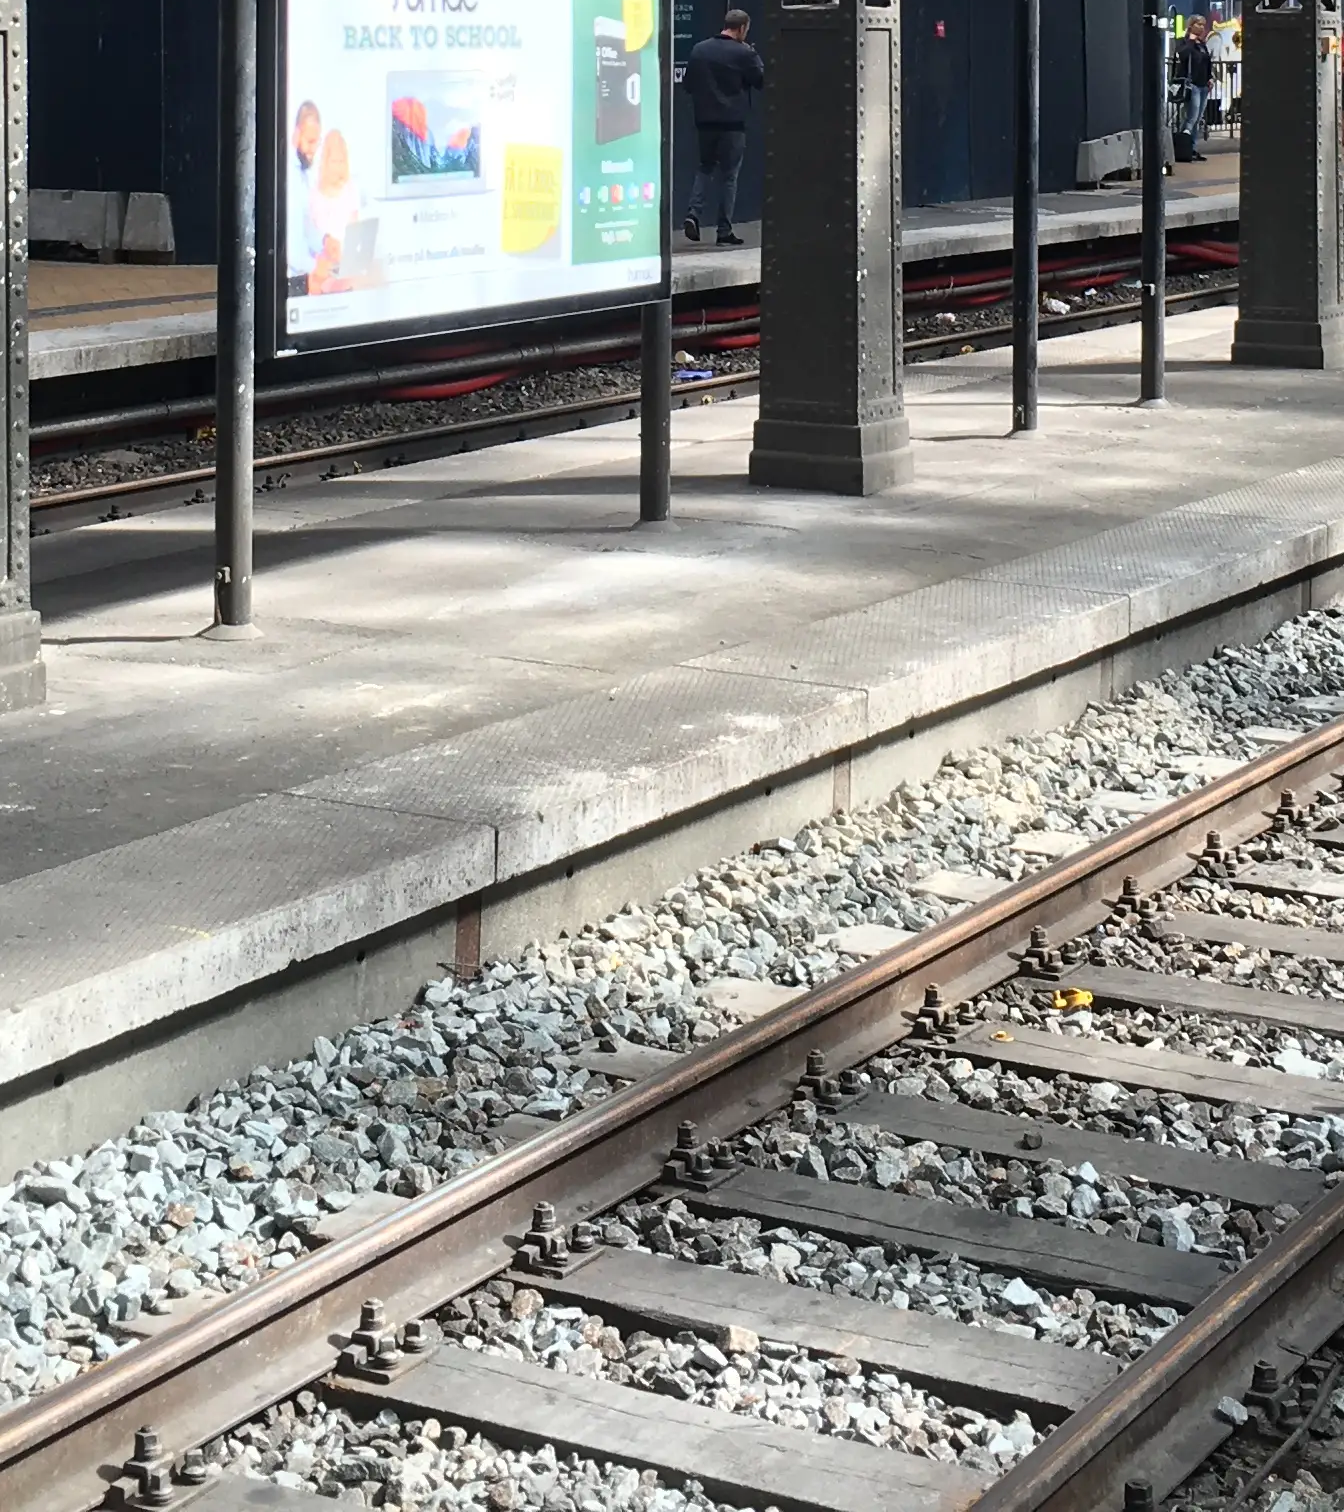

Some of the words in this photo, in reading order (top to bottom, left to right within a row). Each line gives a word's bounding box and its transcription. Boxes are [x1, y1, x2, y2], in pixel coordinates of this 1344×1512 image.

[343, 24, 403, 50] BACK
[410, 24, 439, 49] TO
[445, 24, 523, 50] SCHOOL
